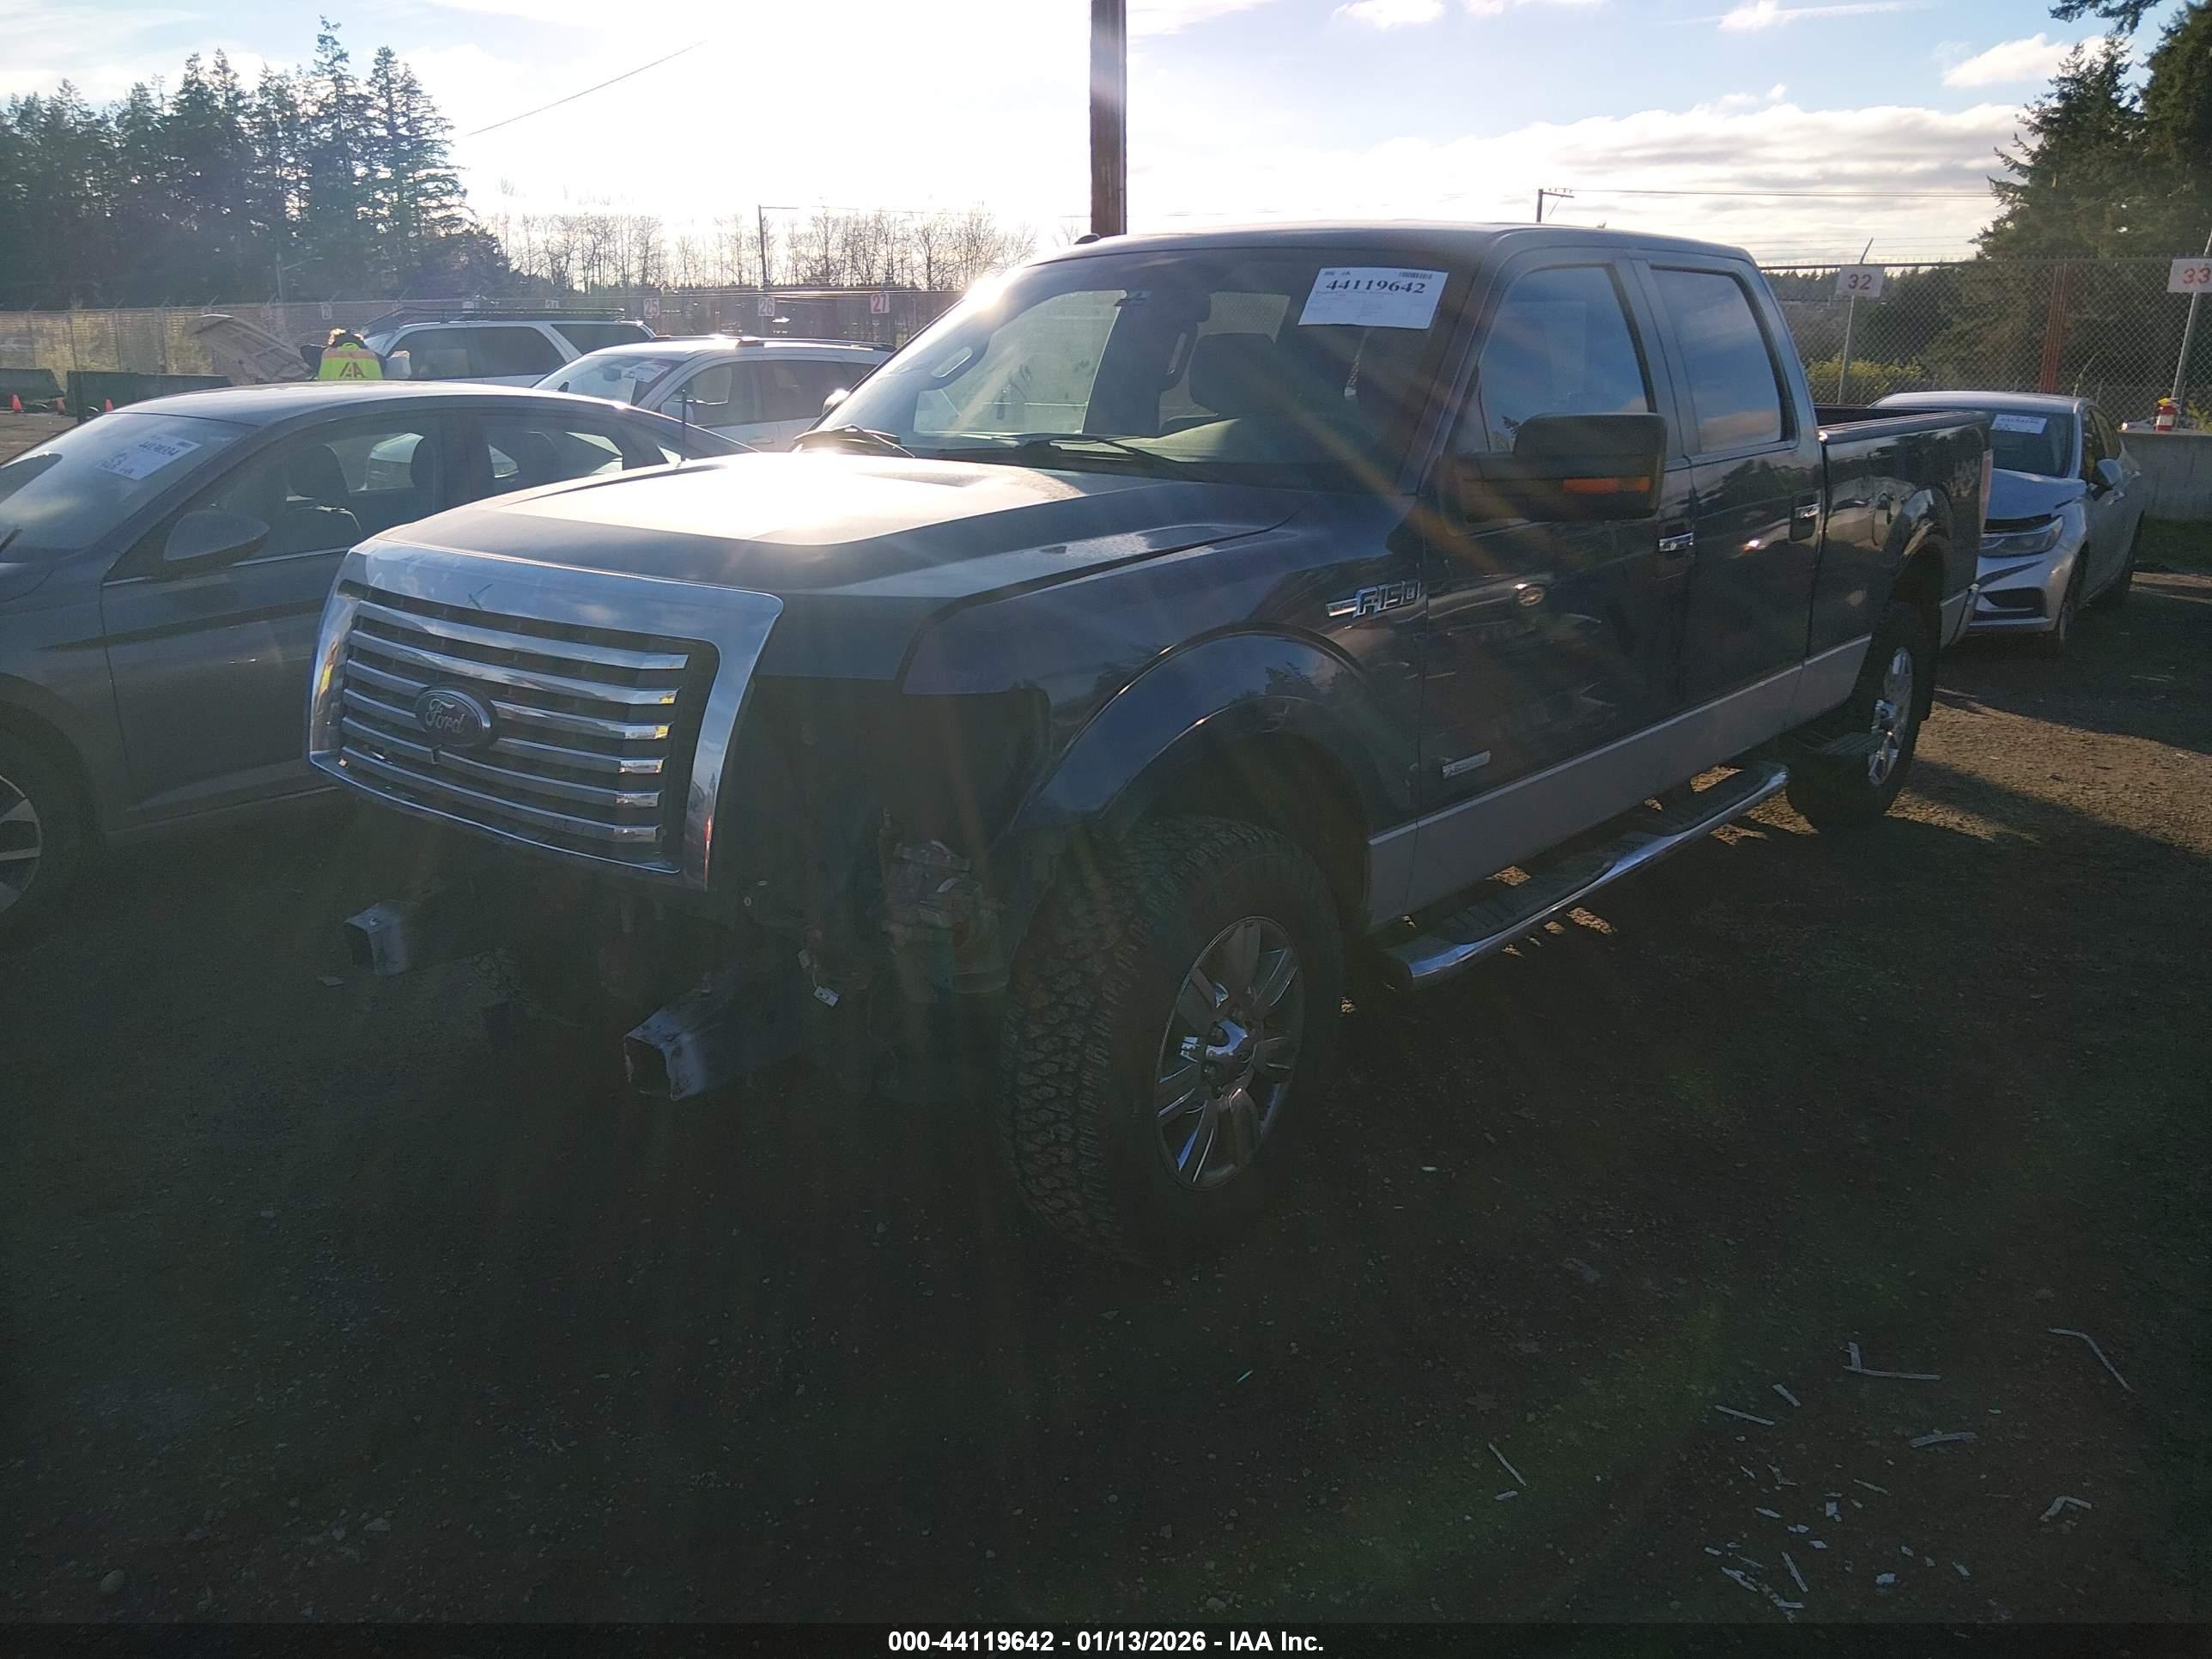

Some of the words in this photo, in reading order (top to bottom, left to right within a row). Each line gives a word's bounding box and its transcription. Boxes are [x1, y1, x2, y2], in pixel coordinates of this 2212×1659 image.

[1848, 274, 1872, 289] 32
[2184, 267, 2211, 284] 33
[1326, 280, 1426, 294] 44119642
[645, 299, 659, 315] 25
[759, 299, 775, 316] 26
[872, 294, 887, 313] 27
[425, 698, 466, 735] Ford
